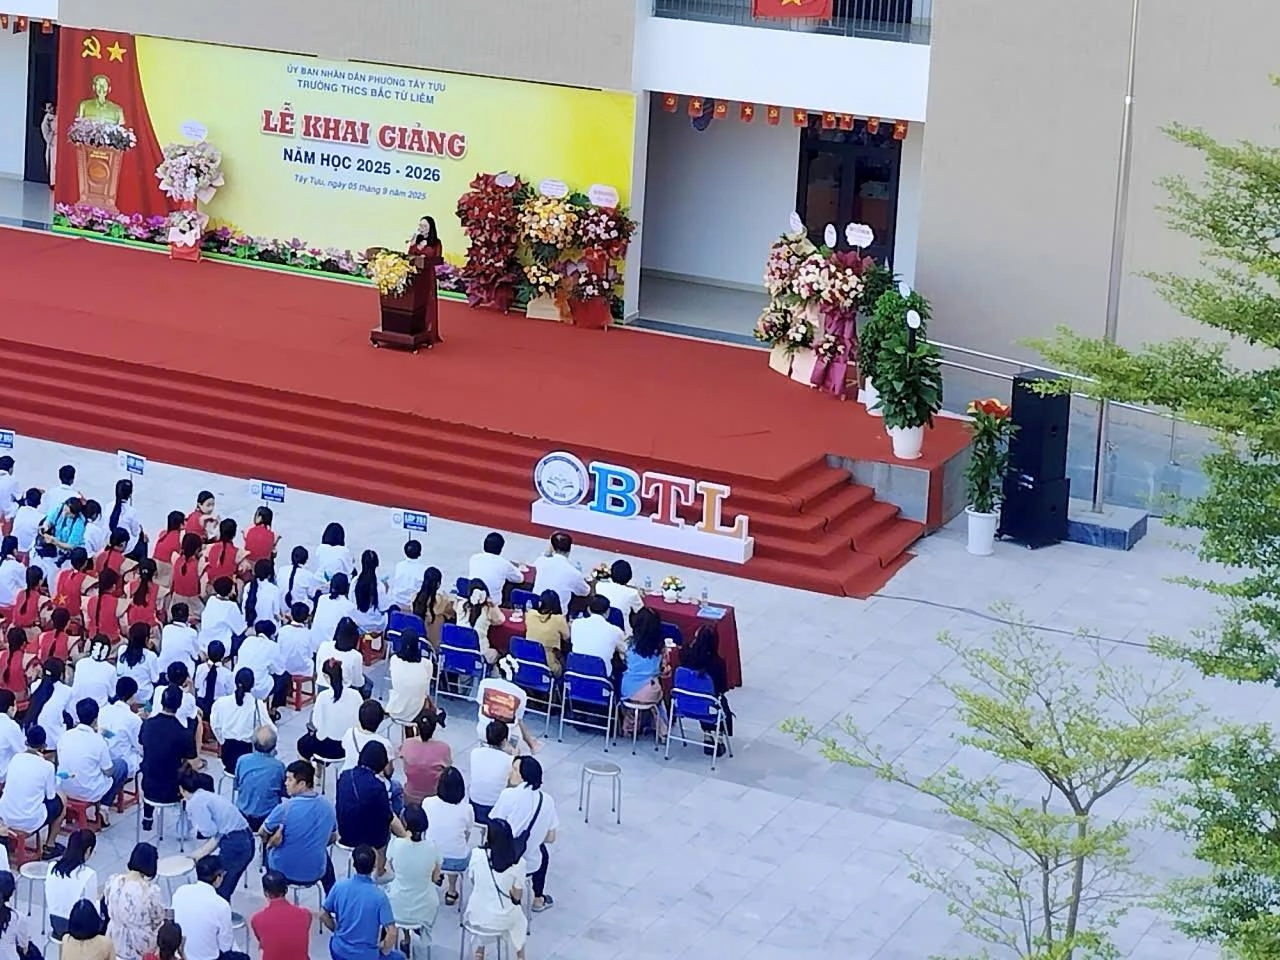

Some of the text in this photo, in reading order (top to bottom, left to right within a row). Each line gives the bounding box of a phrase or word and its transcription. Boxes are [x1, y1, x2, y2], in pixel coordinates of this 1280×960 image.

[301, 66, 319, 77] BAN
[321, 68, 345, 80] NHÂN
[348, 70, 366, 83] DÂN
[408, 77, 426, 89] TÂY
[341, 84, 368, 96] THCS
[410, 91, 434, 104] LIÊM
[262, 101, 466, 157] LỄ KHAI GIẢNG
[283, 146, 316, 165] NĂM
[320, 152, 352, 171] HỌC
[356, 158, 391, 175] 2025
[405, 165, 441, 182] 2026
[348, 181, 358, 191] 05
[407, 190, 427, 201] 2025
[588, 461, 749, 540] BTL
